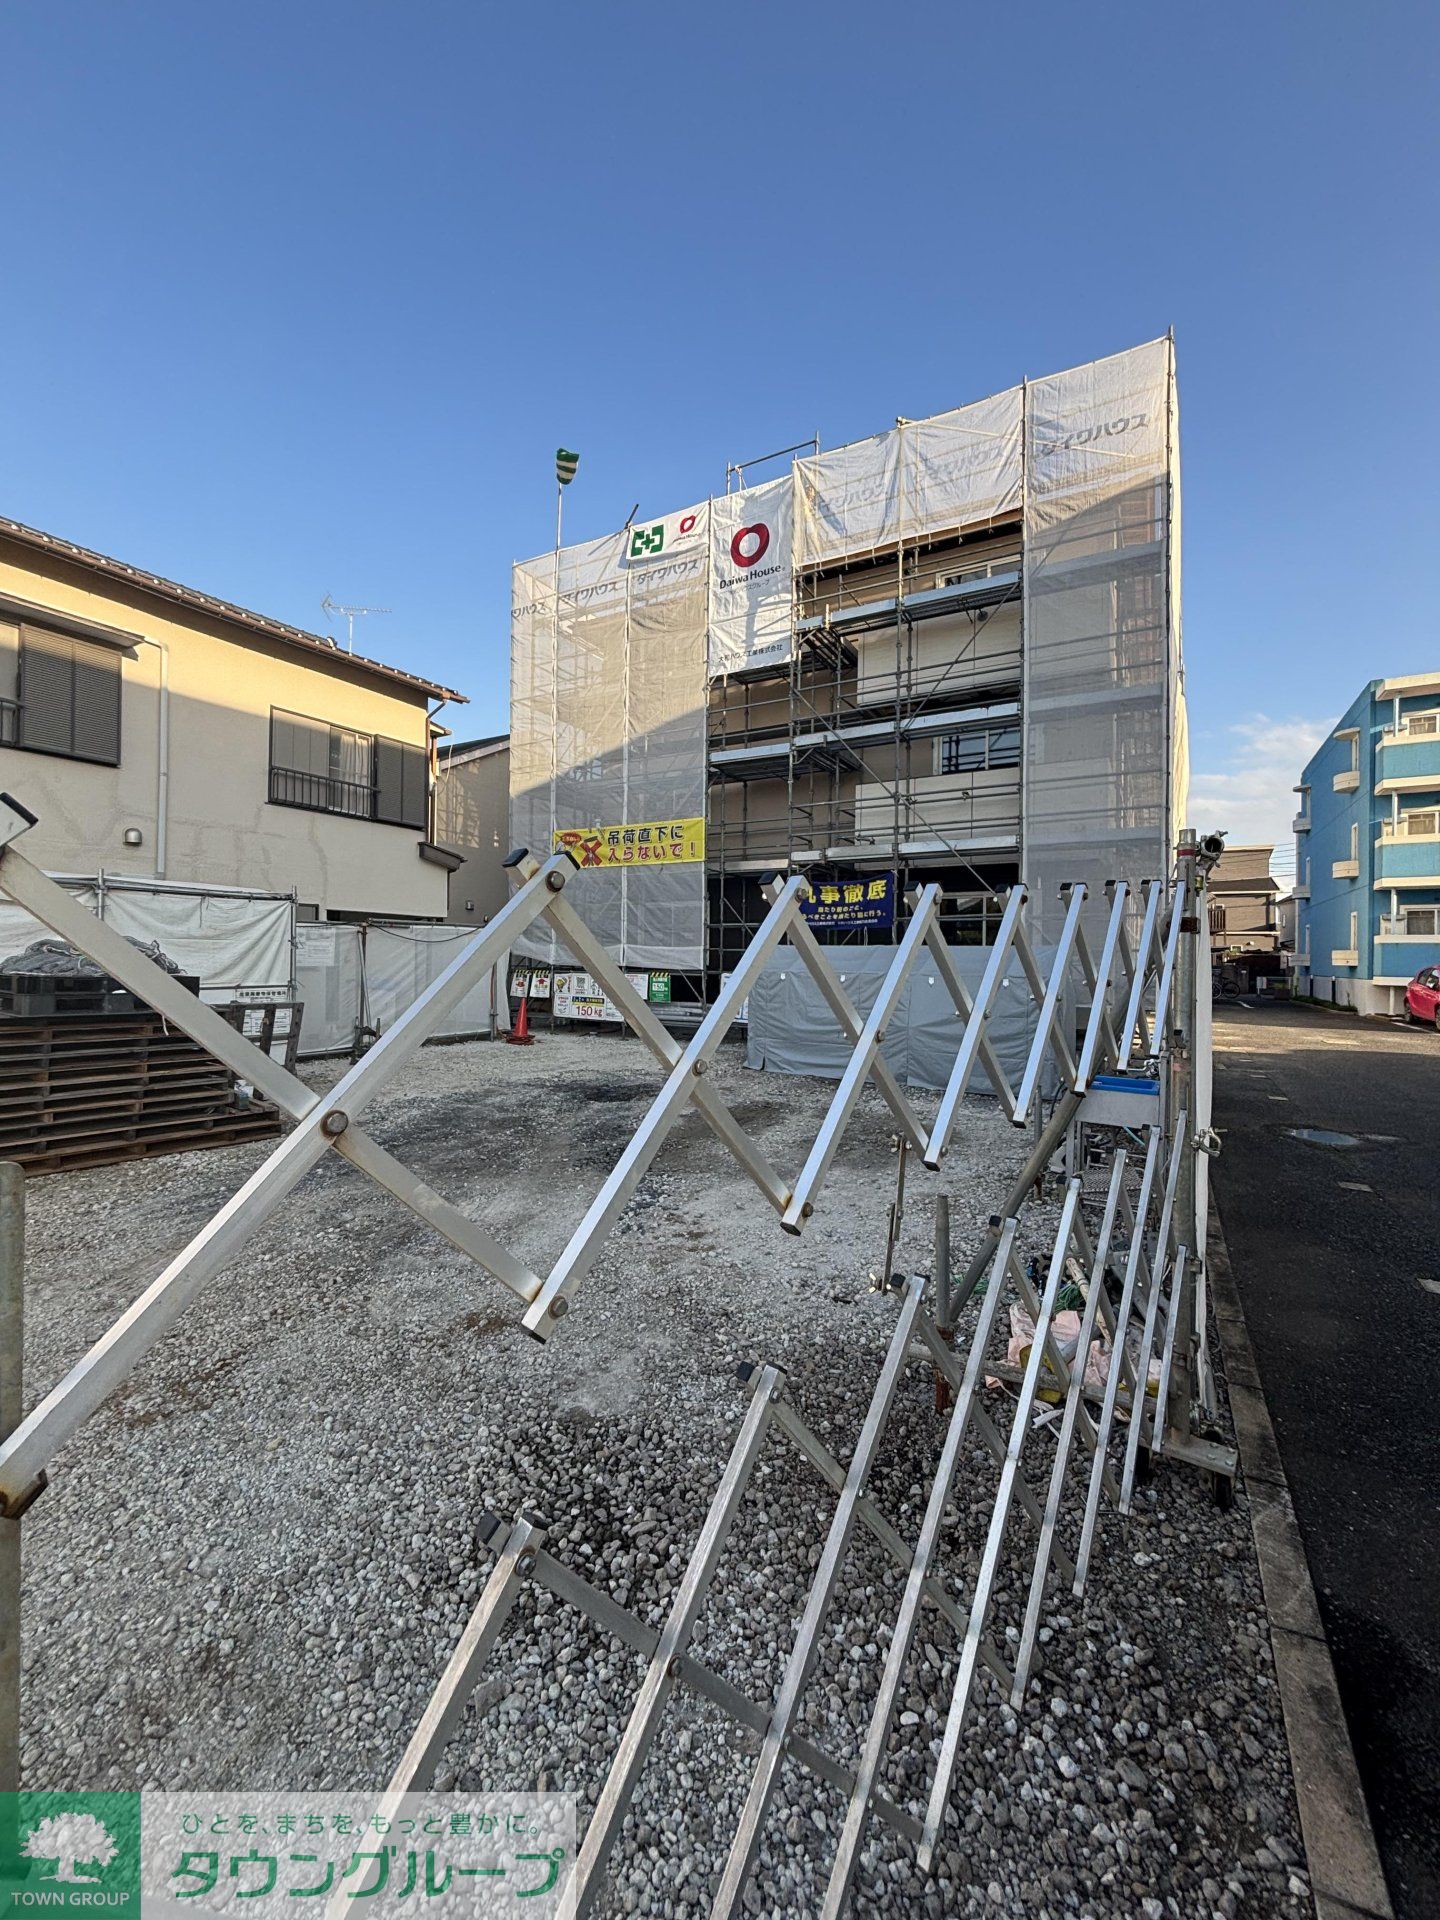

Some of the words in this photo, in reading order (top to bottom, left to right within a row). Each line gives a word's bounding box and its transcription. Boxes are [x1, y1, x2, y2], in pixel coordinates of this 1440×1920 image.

[720, 575, 748, 589] Daiwa
[749, 564, 781, 580] House
[607, 825, 683, 846] 吊荷直下に
[576, 1006, 593, 1016] 150
